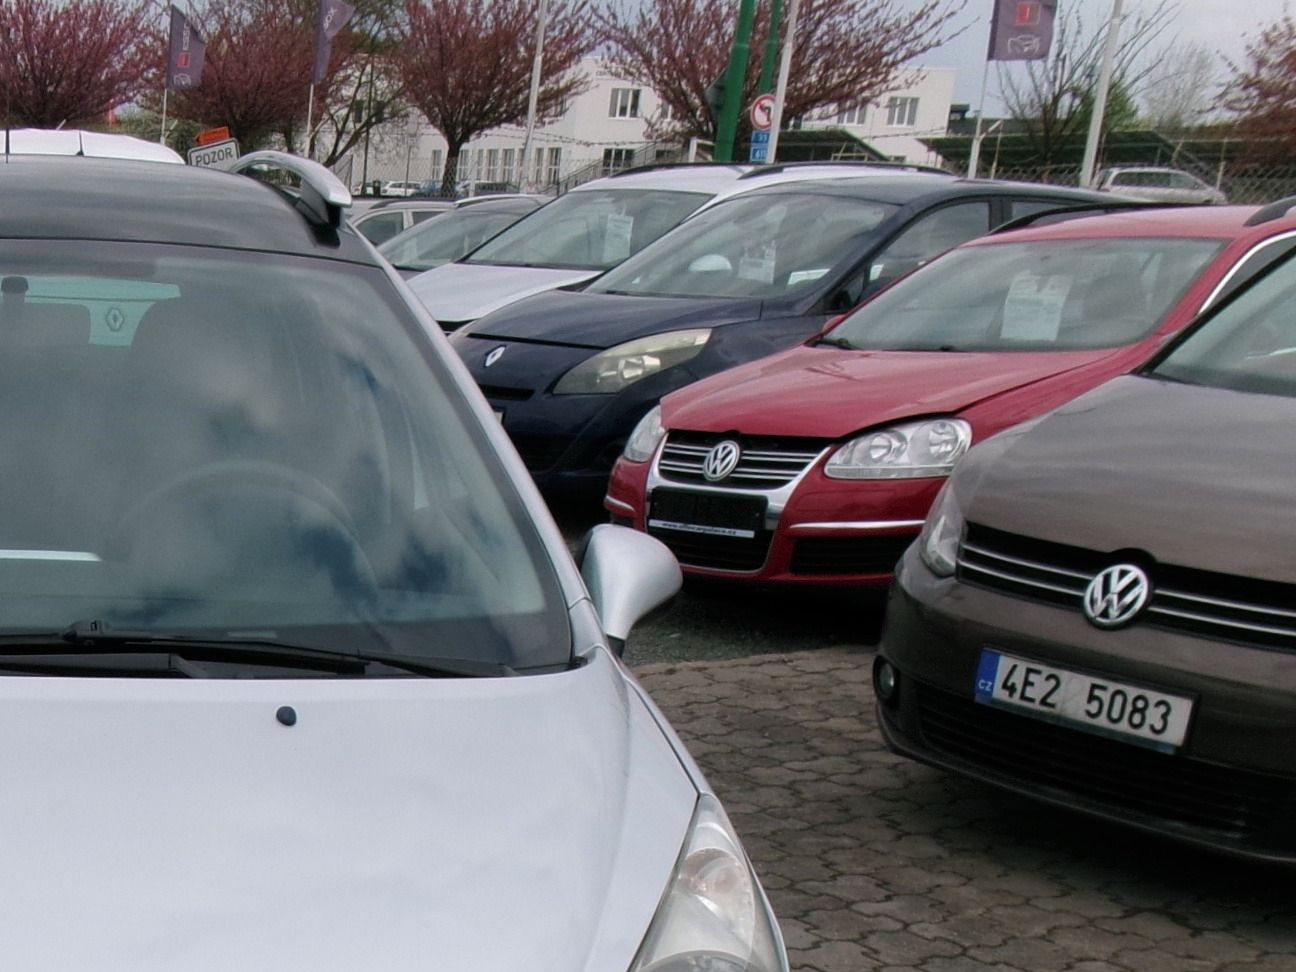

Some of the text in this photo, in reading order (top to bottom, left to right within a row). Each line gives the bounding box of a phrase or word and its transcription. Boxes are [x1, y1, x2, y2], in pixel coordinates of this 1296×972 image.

[195, 147, 233, 166] POZOR
[1084, 564, 1149, 626] VW
[977, 663, 1173, 736] CZ 4E2 5083
